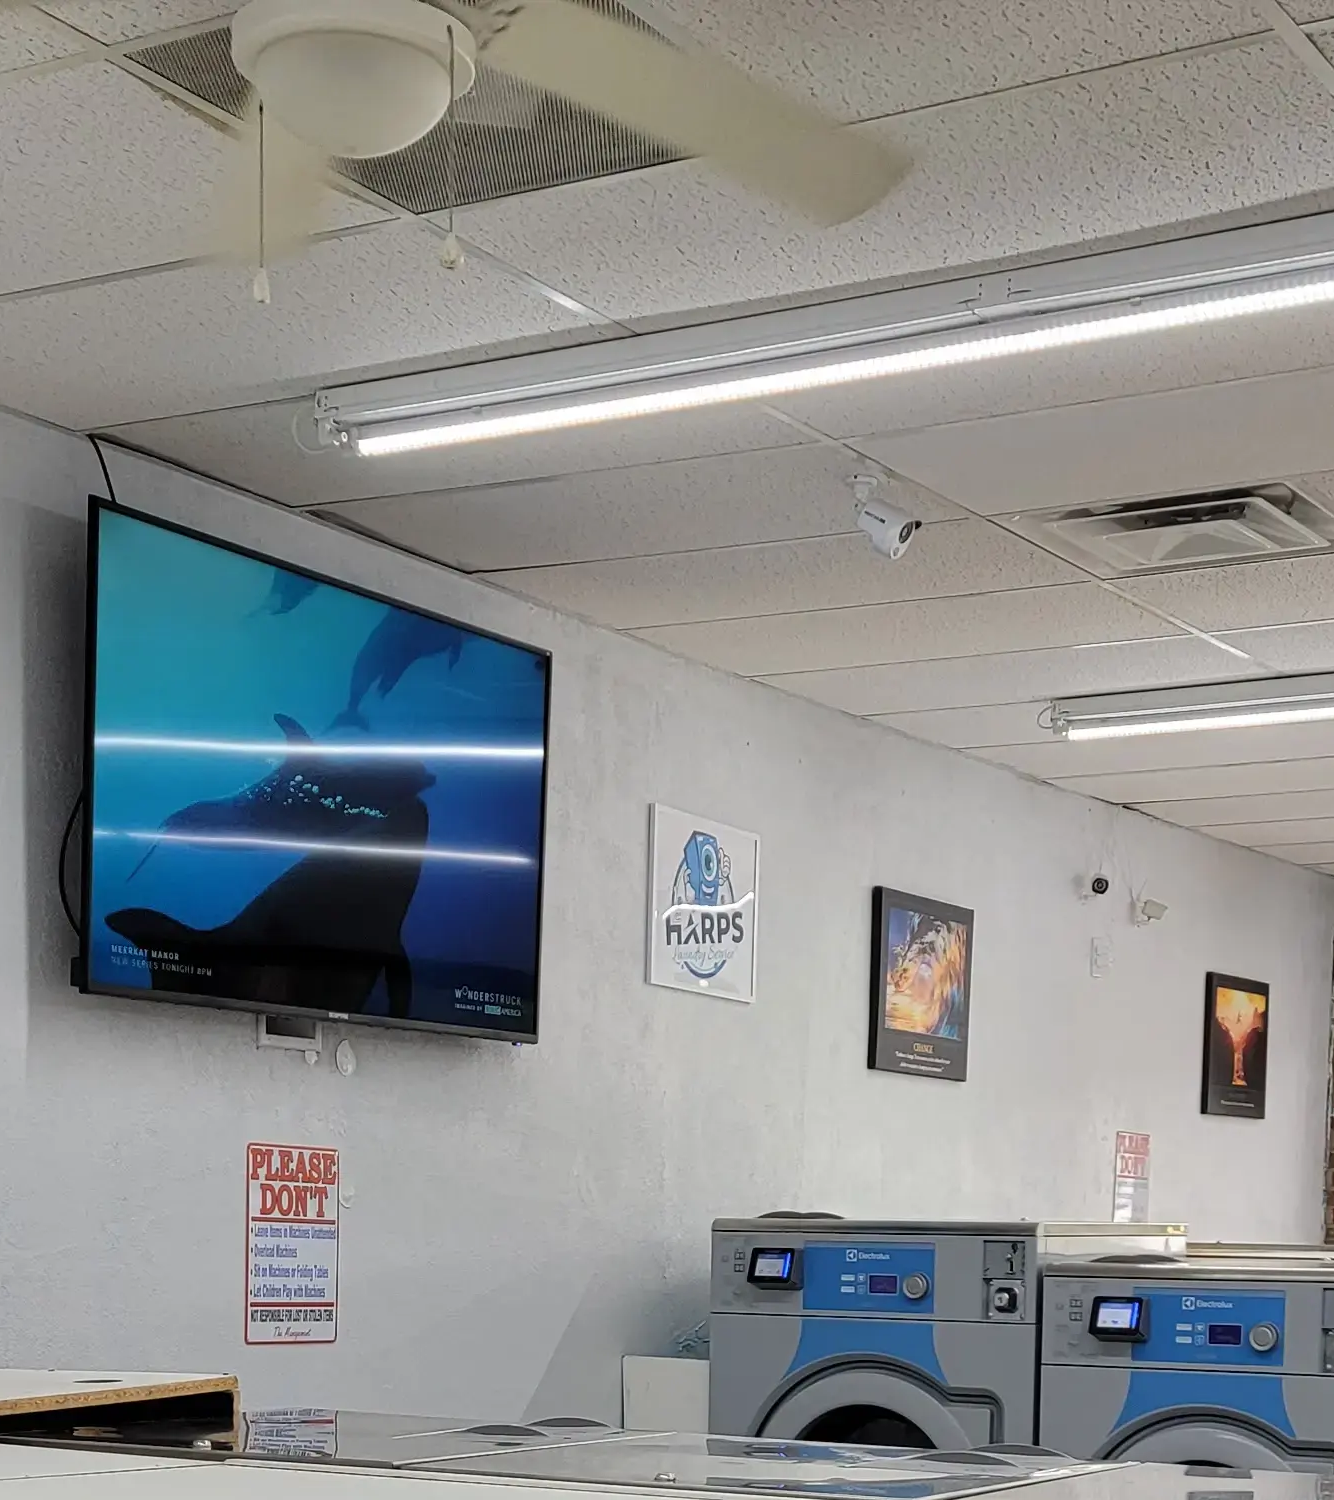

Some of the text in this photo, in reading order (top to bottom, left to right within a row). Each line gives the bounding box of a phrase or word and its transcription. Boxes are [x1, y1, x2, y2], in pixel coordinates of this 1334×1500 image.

[666, 911, 744, 945] HARPS
[111, 944, 179, 960] MEERKAT MANOR
[161, 962, 194, 974] TONIGHT
[455, 986, 522, 1006] WONDERSTRUCK
[250, 1148, 336, 1185] PLEASE
[260, 1183, 329, 1218] DON'T
[276, 1245, 297, 1258] Machines
[858, 1250, 890, 1261] Electrolux
[269, 1264, 290, 1277] Machines
[304, 1284, 325, 1298] Machines
[1196, 1299, 1234, 1309] Electrolux
